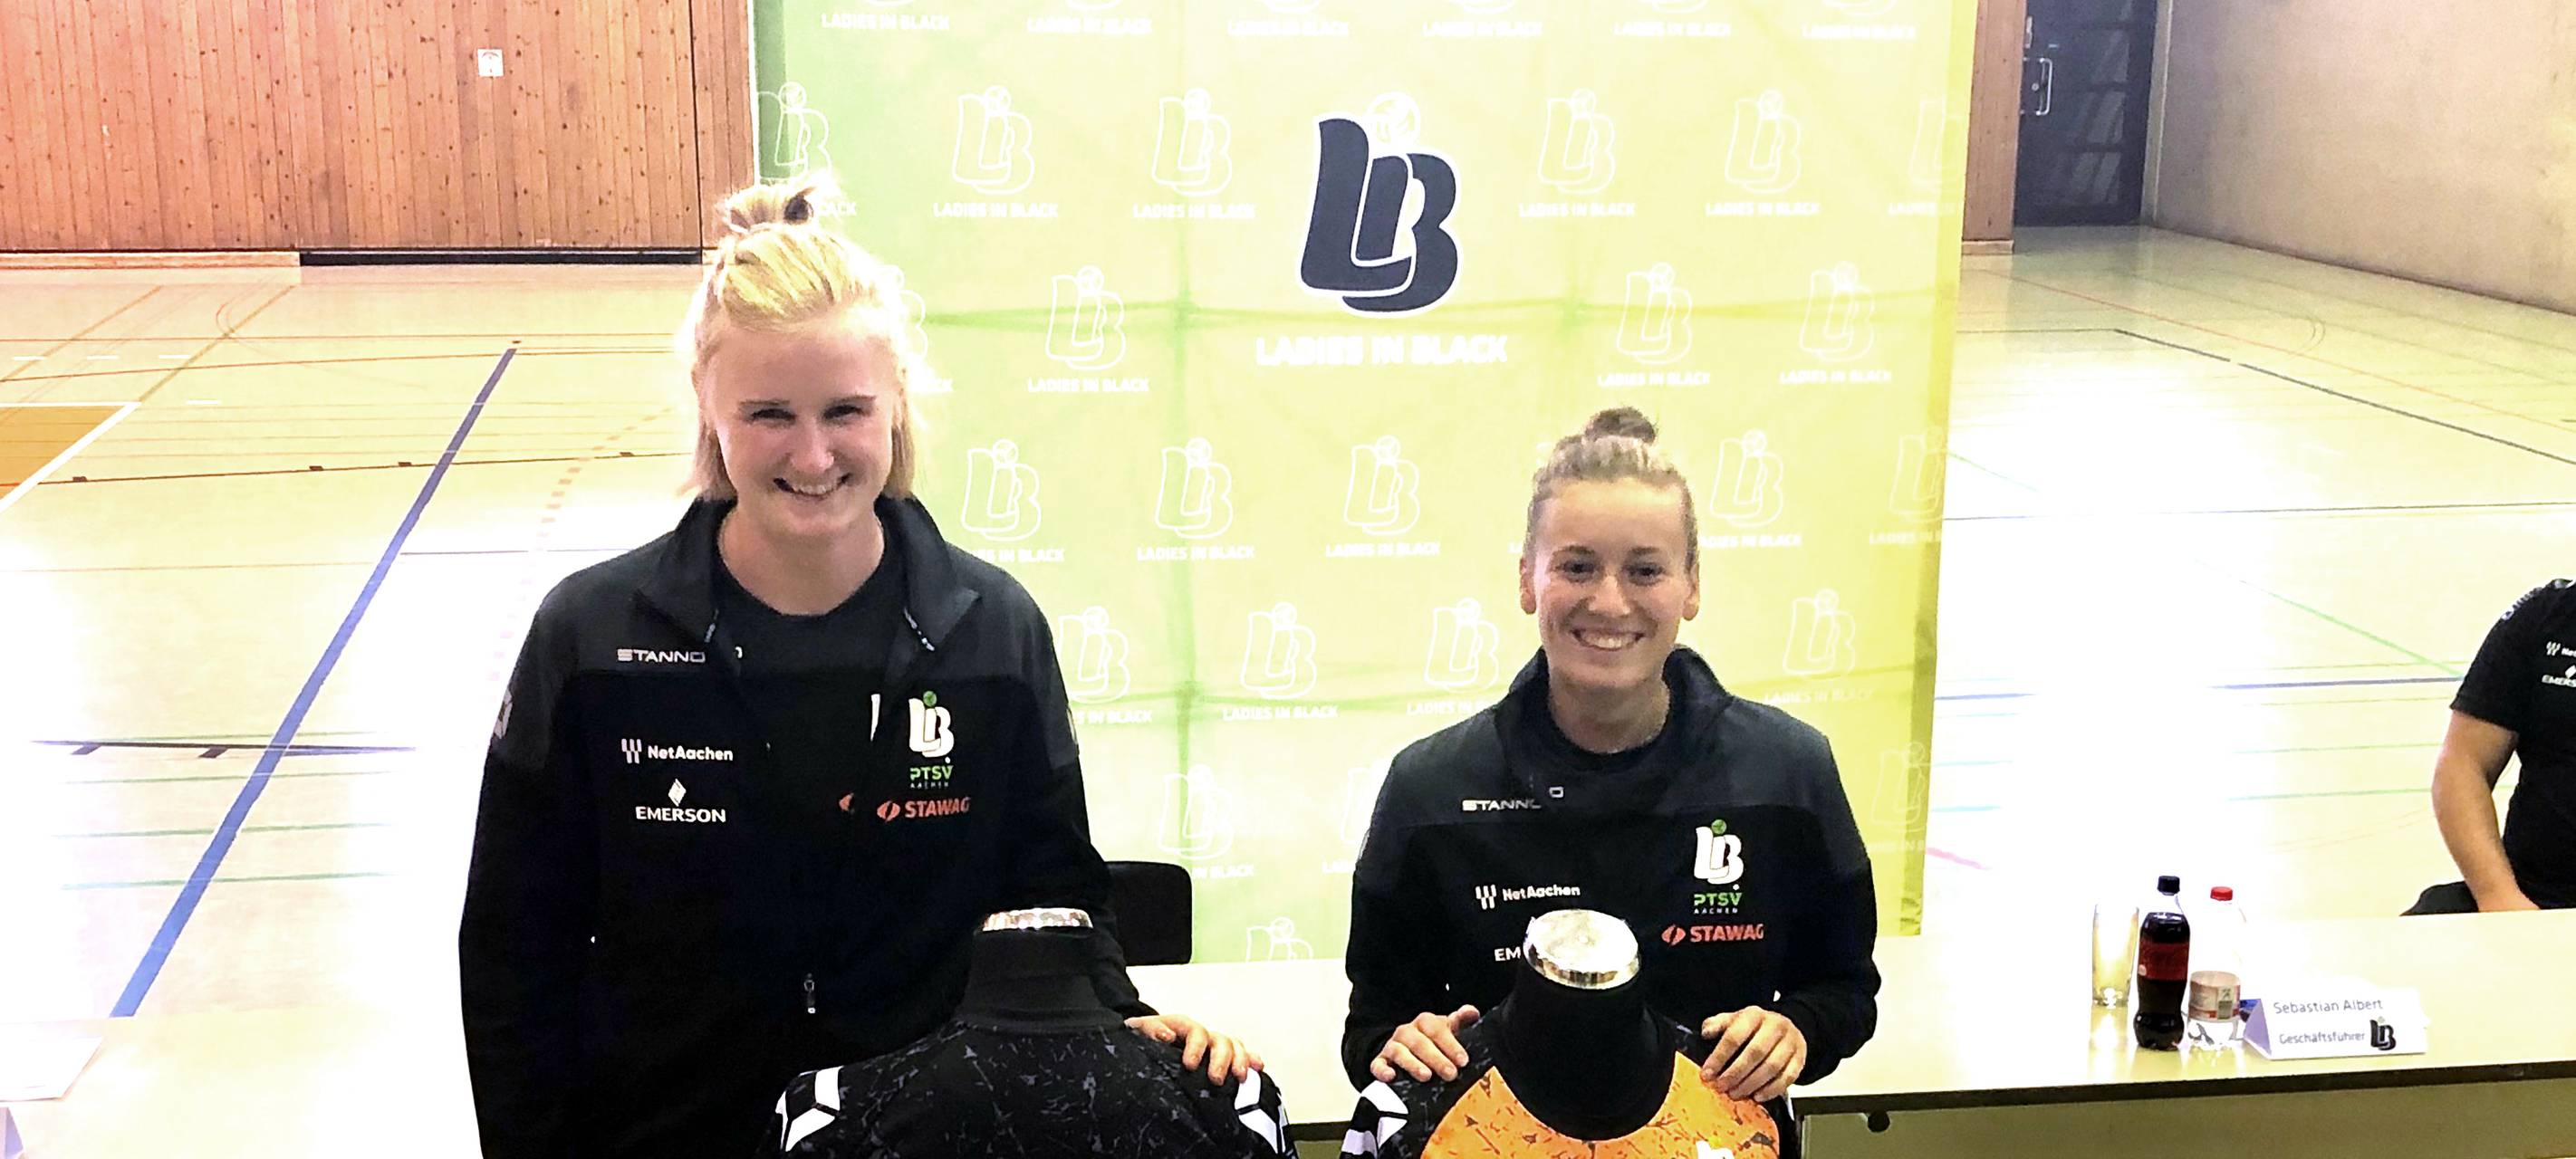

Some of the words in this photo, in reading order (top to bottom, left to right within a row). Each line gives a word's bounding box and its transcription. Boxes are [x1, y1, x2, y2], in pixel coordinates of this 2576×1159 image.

[933, 202, 986, 217] LADIES
[990, 202, 1007, 217] IN
[1010, 202, 1059, 217] BLACK
[1255, 334, 1363, 365] LADIES
[1371, 334, 1405, 365] IN
[1410, 334, 1508, 365] BLACK
[1028, 376, 1080, 392] LADIES
[1082, 376, 1100, 392] IN
[1101, 376, 1149, 392] BLACK
[617, 648, 706, 663] STANNO
[1223, 706, 1274, 722] LADIES
[1275, 706, 1291, 720] IN
[1293, 705, 1339, 720] BLACK
[648, 745, 734, 761] NetAachen
[909, 765, 954, 781] PTSV
[635, 806, 726, 823] EMERSON
[905, 797, 971, 819] STAWAG
[1503, 884, 1581, 902] NetAachen
[1694, 892, 1744, 906] PTSV
[1690, 924, 1764, 943] STAWAG
[2273, 1001, 2340, 1015] Sebastian
[2343, 999, 2384, 1011] Albert
